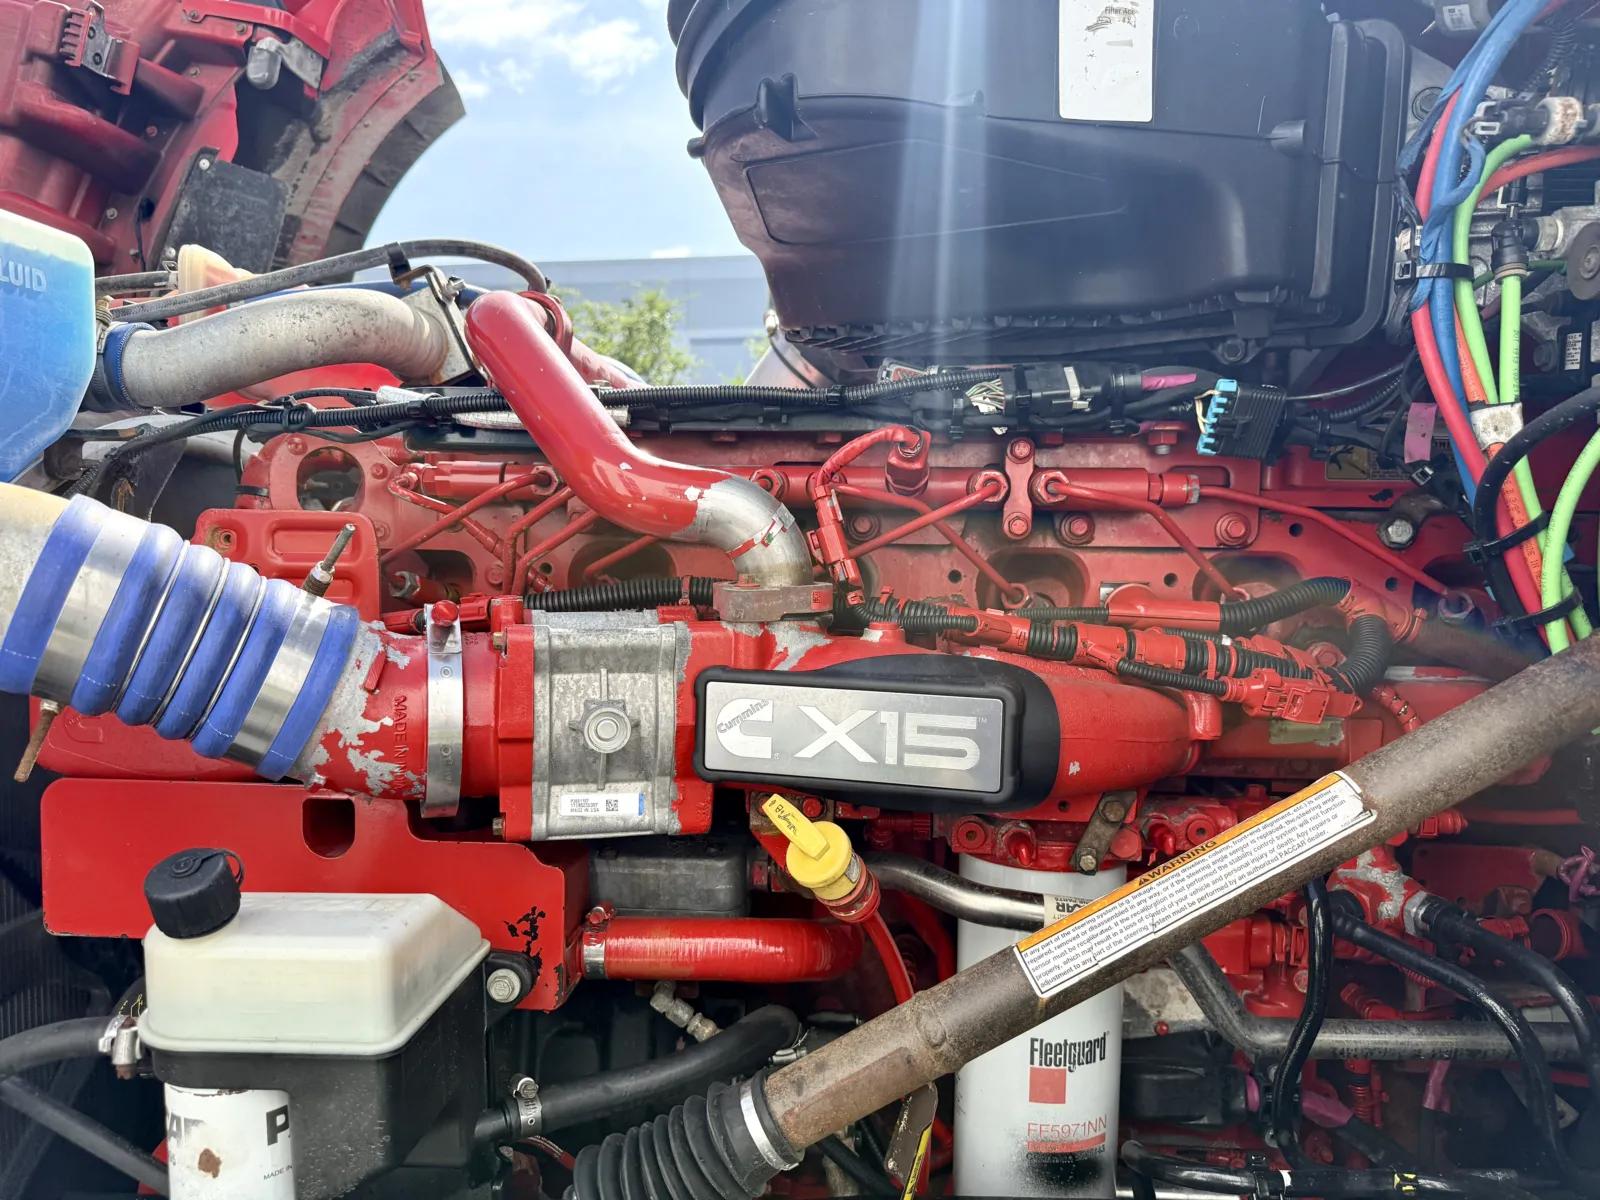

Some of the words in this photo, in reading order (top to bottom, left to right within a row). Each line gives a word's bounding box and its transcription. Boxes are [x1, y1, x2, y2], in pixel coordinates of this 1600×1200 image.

[394, 695, 407, 741] MADE
[717, 699, 769, 734] Cummins
[793, 705, 980, 770] X15
[1026, 947, 1054, 965] repaired,
[1053, 933, 1079, 950] removed
[1087, 906, 1128, 931] disassembled
[1136, 897, 1147, 907] any
[1147, 890, 1162, 900] way,
[1174, 875, 1185, 884] the
[1185, 862, 1211, 880] steering
[1210, 853, 1228, 866] angle
[1228, 842, 1249, 856] sensor
[1255, 822, 1286, 841] replaced,
[1284, 816, 1295, 825] the
[1294, 802, 1322, 821] steering
[1321, 793, 1339, 806] angle
[1031, 958, 1051, 971] sensor
[1051, 948, 1067, 960] must
[1076, 924, 1113, 947] recalibrated.
[1119, 915, 1130, 924] the
[1129, 895, 1167, 918] recalibration
[1174, 885, 1185, 894] not
[1185, 868, 1217, 889] performed
[1217, 862, 1228, 871] the
[1228, 849, 1253, 866] stability
[1252, 837, 1275, 852] control
[1274, 824, 1298, 841] system
[1297, 818, 1309, 828] will
[1309, 812, 1320, 822] not
[1320, 798, 1346, 816] function
[1147, 838, 1217, 879] WARNING
[1034, 962, 1062, 980] properly,
[1061, 951, 1080, 964] which
[1080, 945, 1094, 955] may
[1093, 933, 1111, 946] result
[1123, 920, 1136, 930] loss
[1144, 904, 1167, 920] control
[1174, 894, 1189, 905] your
[1188, 881, 1211, 897] vehicle
[1210, 874, 1223, 885] and
[1222, 860, 1250, 879] personal
[1249, 850, 1268, 864] injury
[1275, 835, 1295, 850] death.
[1295, 828, 1309, 840] Any
[1308, 817, 1331, 833] repairs
[1039, 966, 1073, 988] adjustment
[1080, 956, 1093, 966] any
[1092, 946, 1105, 957] part
[1104, 942, 1112, 950] of
[1111, 937, 1123, 946] the
[1122, 923, 1149, 941] steering
[1170, 903, 1187, 916] must
[1186, 898, 1196, 907] be
[1196, 881, 1228, 903] performed
[1227, 876, 1237, 886] by
[1245, 854, 1279, 875] authorized
[1278, 839, 1306, 857] PACCAR
[1306, 827, 1328, 842] dealer.
[1029, 1032, 1107, 1073] Fleetguard
[263, 1170, 284, 1181] MADE
